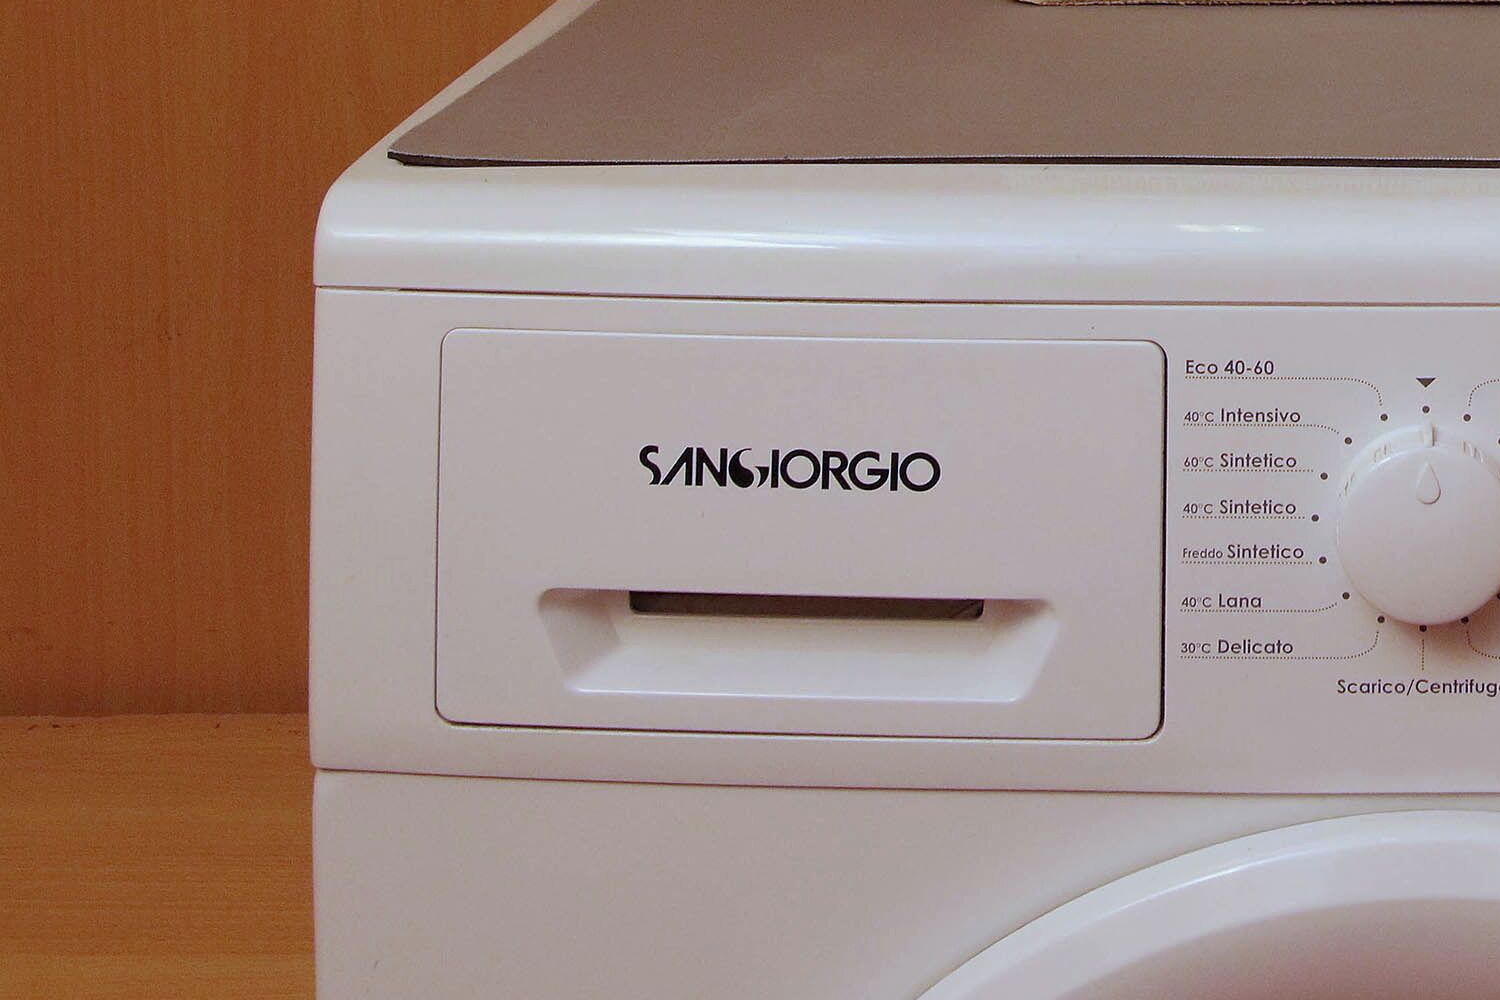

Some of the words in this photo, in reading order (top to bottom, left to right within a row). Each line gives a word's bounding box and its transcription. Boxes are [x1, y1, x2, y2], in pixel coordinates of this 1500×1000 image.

[1185, 359, 1219, 375] Eco
[1223, 359, 1274, 376] 40-60
[1183, 411, 1215, 425] 40°C
[1220, 407, 1301, 423] Intensivo
[1183, 456, 1214, 468] 60°C
[1220, 452, 1297, 468] Sintetico
[1182, 503, 1214, 515] 40°C
[1219, 499, 1297, 515] Sintetico
[1182, 547, 1224, 559] freddo
[1227, 543, 1304, 560] Sintetico
[1181, 596, 1212, 608] 40°C
[1218, 593, 1262, 609] Lana
[1180, 642, 1211, 654] 30°C
[1217, 638, 1294, 655] Delicato
